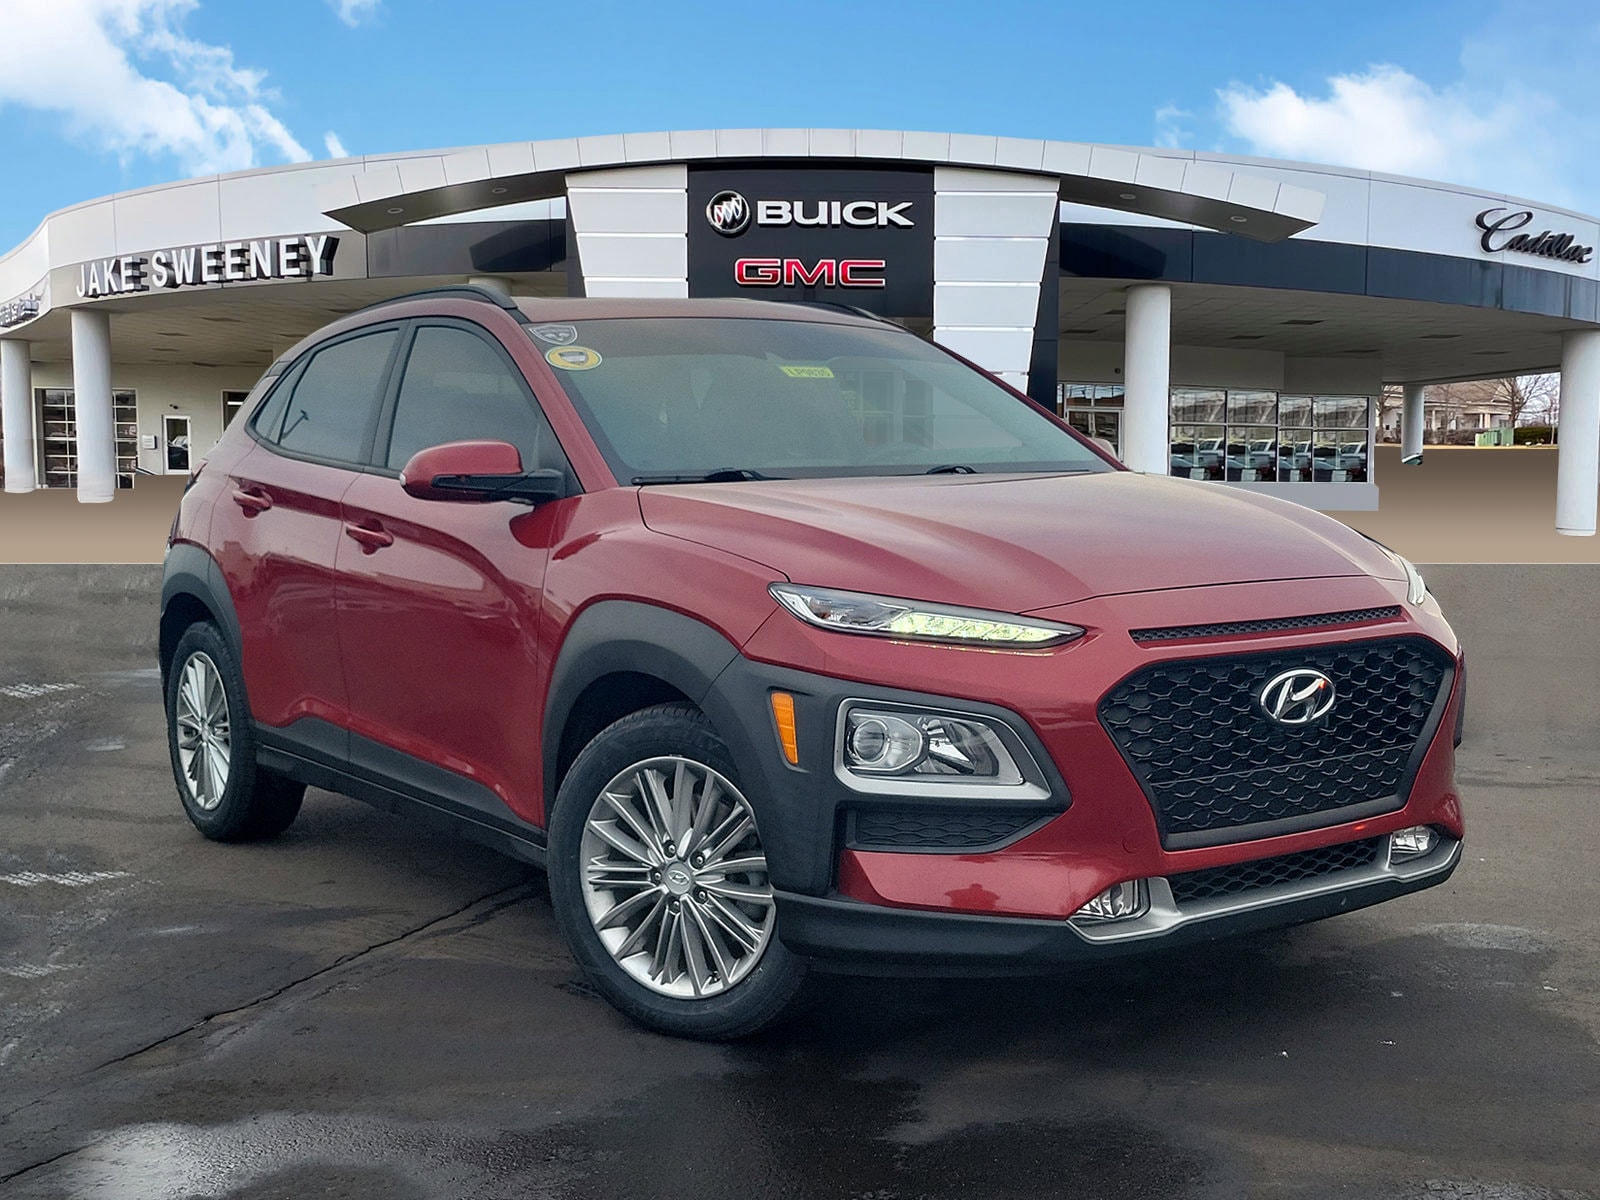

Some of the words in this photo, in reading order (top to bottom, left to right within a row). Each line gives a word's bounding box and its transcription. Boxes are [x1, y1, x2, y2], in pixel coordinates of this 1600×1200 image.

[757, 200, 915, 226] BUICK
[1475, 207, 1593, 263] Cadillac
[76, 256, 149, 298] JAKE
[152, 234, 339, 289] SWEENEY
[735, 258, 886, 287] GMC
